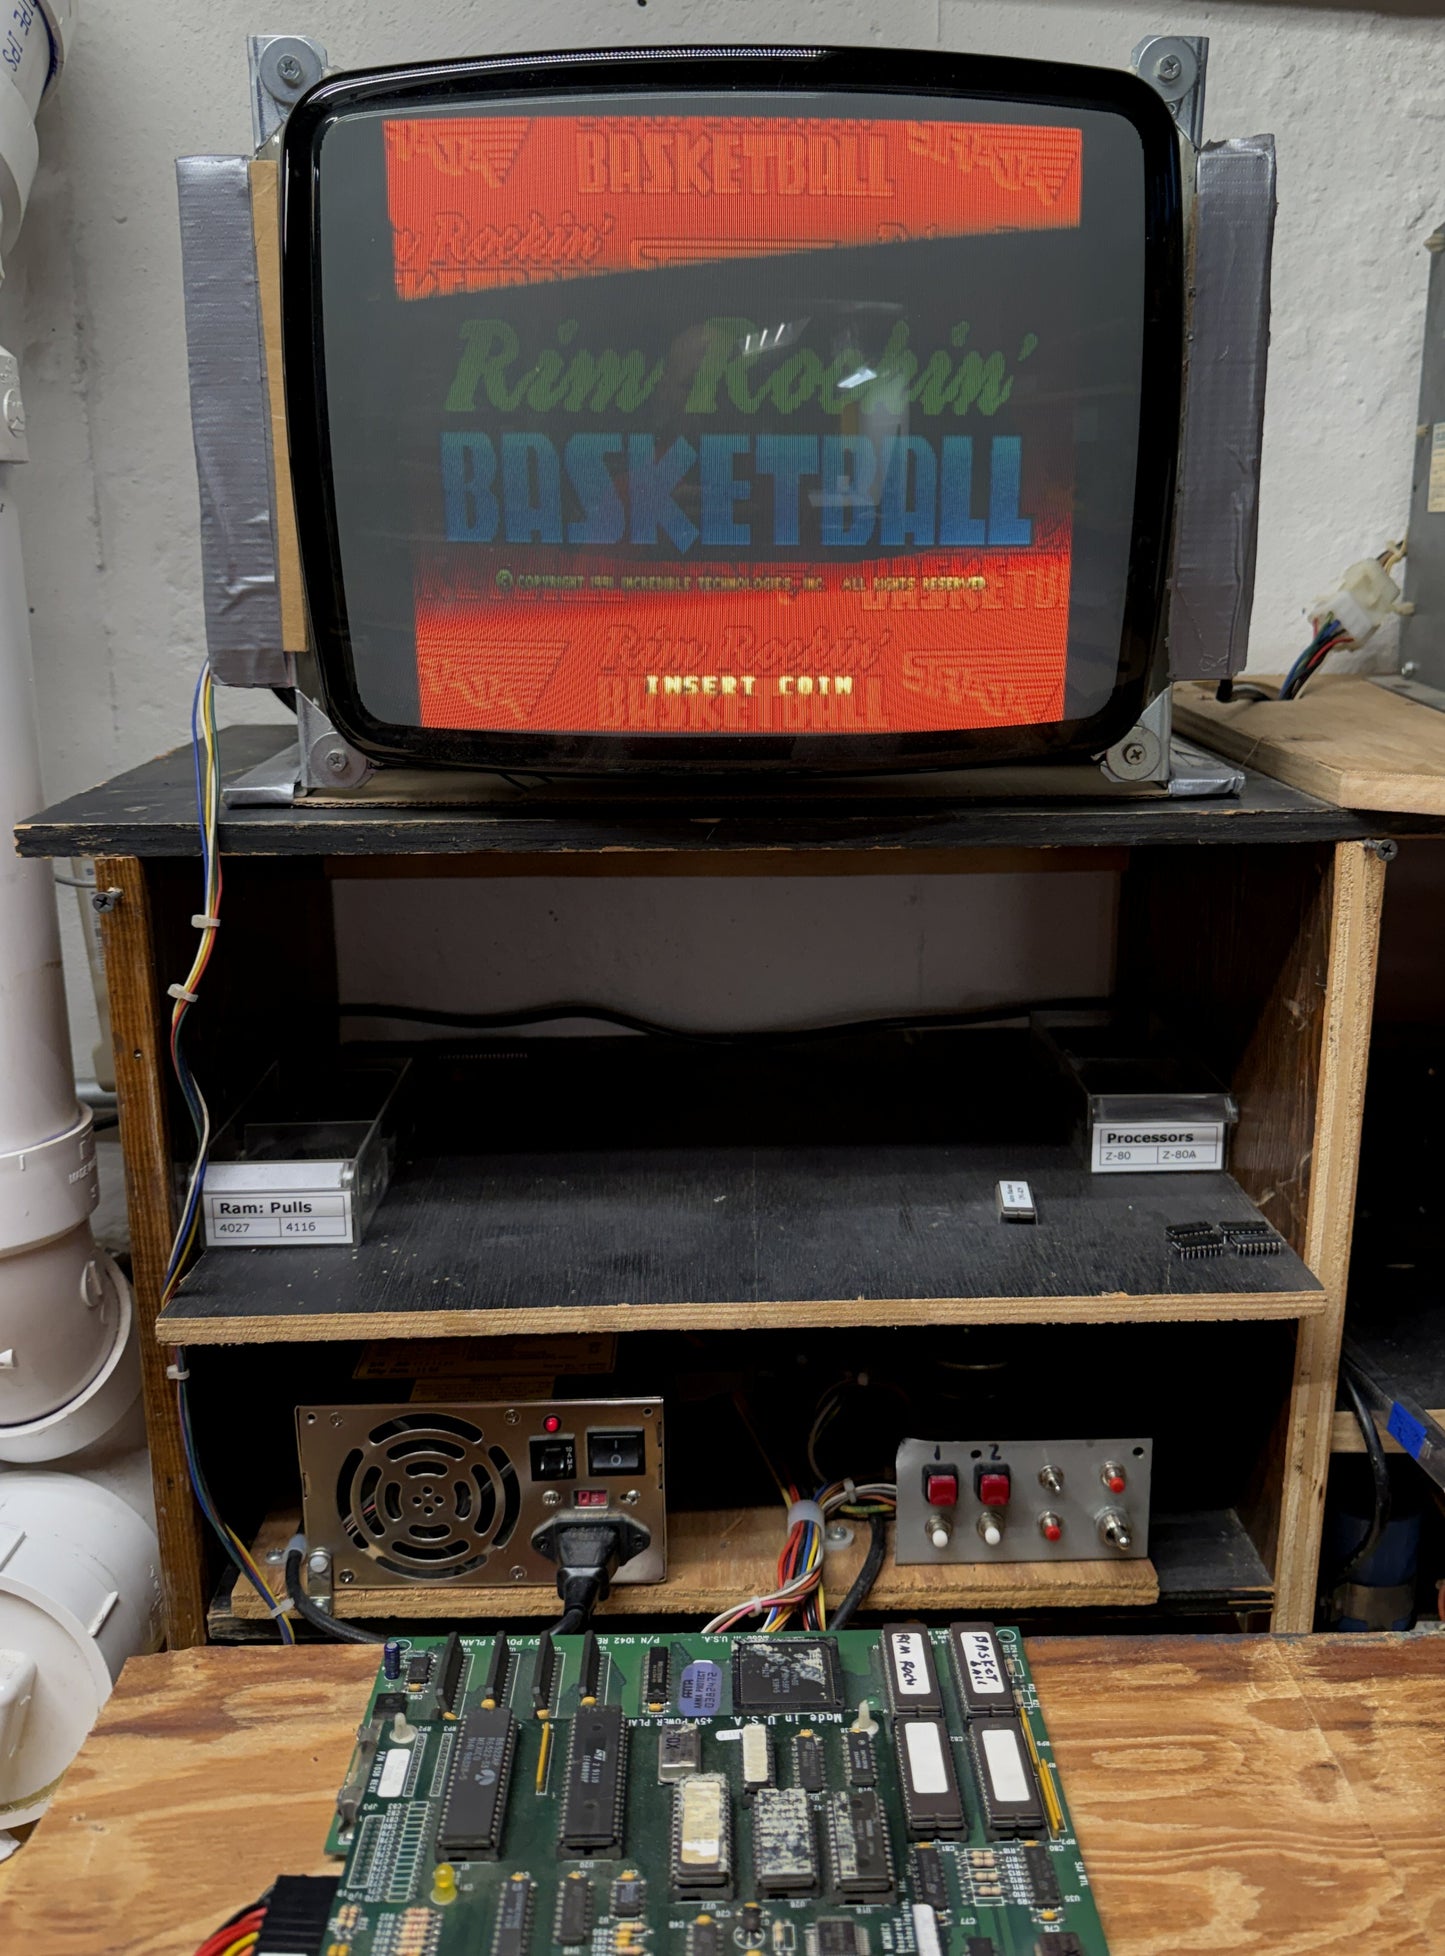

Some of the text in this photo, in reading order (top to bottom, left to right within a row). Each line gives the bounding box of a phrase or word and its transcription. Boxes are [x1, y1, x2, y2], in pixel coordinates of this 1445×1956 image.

[575, 125, 896, 198] BASKETBALL
[443, 316, 1039, 416] Rim Rockin'
[439, 430, 1033, 554] BASKETBALL
[518, 574, 584, 591] COPYRIGHT
[621, 575, 692, 592] INCREDIBLE
[842, 575, 867, 592] ALL
[873, 575, 917, 592] RIGHTS
[922, 575, 987, 592] RESERVED
[645, 675, 854, 697] INSERT COIN
[1107, 1132, 1194, 1144] Processors
[1105, 1150, 1197, 1161] Z-80 Z-80A
[220, 1201, 313, 1215] Ram: Pulls
[219, 1222, 316, 1233] 4027 4116
[988, 1443, 1002, 1460] 2
[596, 1636, 660, 1645] P/N 1042 RE
[785, 1714, 799, 1726] in
[809, 1713, 842, 1724] Made
